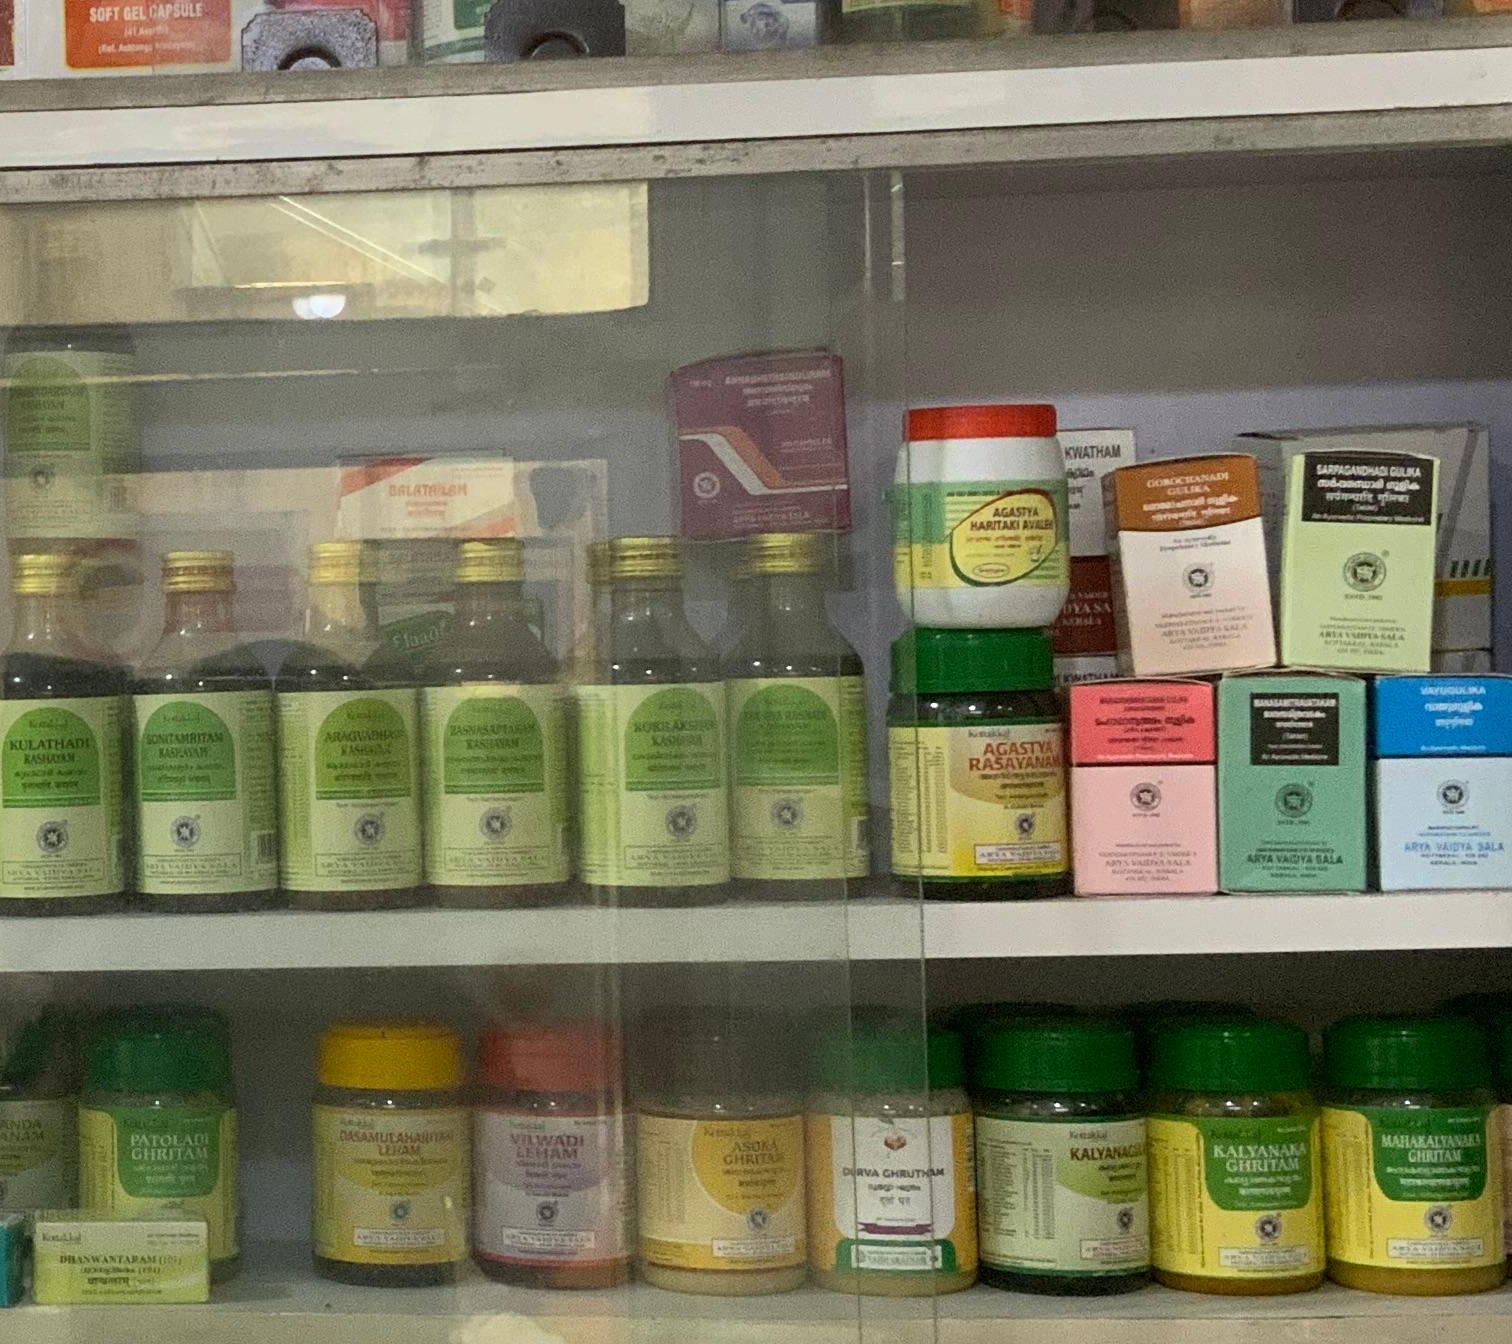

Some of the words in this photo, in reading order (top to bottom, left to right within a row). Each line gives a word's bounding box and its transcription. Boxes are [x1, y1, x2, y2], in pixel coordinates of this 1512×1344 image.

[89, 5, 122, 23] SOFT
[122, 4, 148, 21] GEL
[149, 2, 204, 20] CAPSULE
[1064, 444, 1122, 459] KWATHAM
[1146, 471, 1229, 489] GOROCHANADI
[1167, 484, 1211, 497] GULIKA
[991, 506, 1040, 519] AGASTYA
[970, 519, 1020, 532] HARITAKI
[9, 736, 89, 752] KULATHADI
[982, 741, 1054, 757] AGASTYA
[969, 755, 1062, 772] RASAYANAM
[130, 1131, 209, 1146] PATOLADI
[510, 1133, 585, 1147] VILWADI
[1381, 1132, 1482, 1150] MAHAKALYANAKA
[131, 1146, 208, 1161] GHRITAM
[1214, 1142, 1307, 1159] KALYANAKA
[1407, 1148, 1463, 1163] GHRITAM
[1225, 1157, 1300, 1172] GHRITAM
[59, 1253, 157, 1265] DHANWANTARAM
